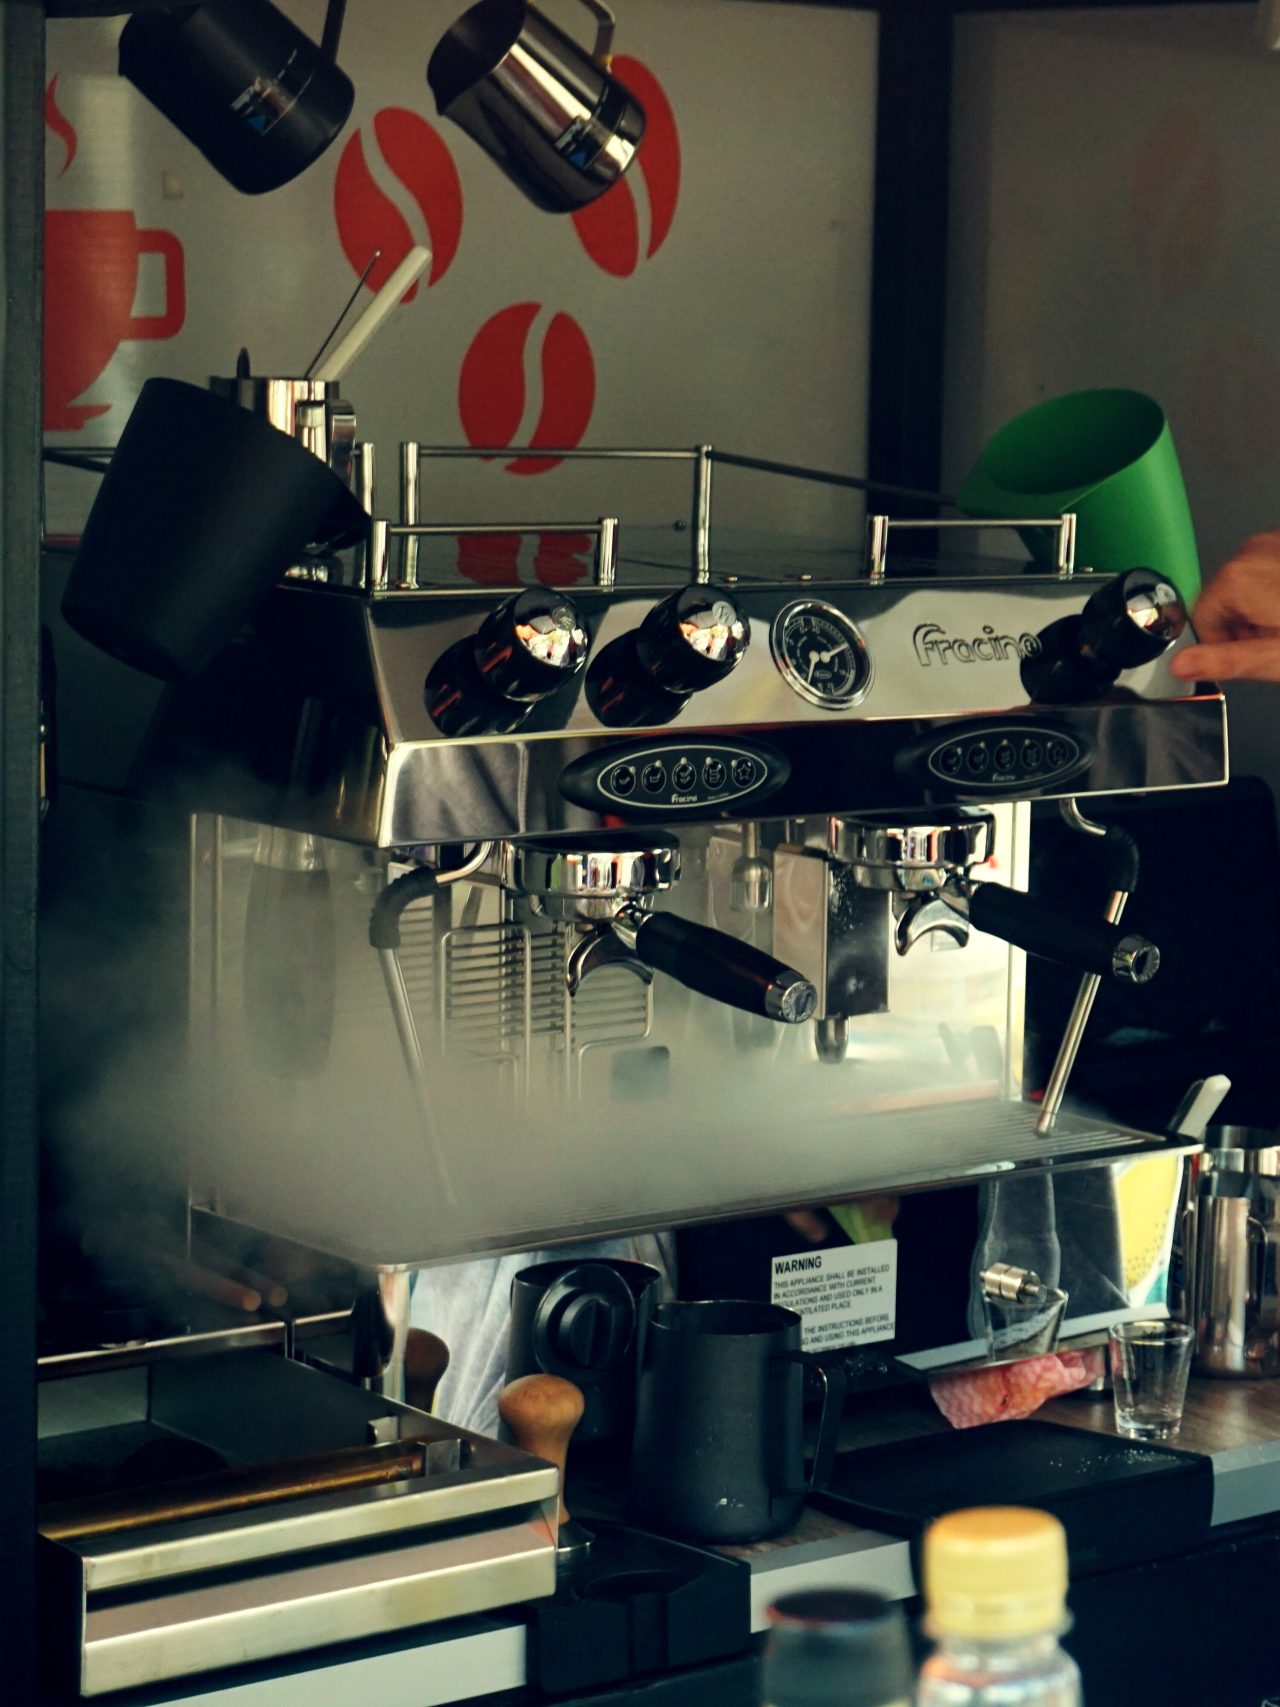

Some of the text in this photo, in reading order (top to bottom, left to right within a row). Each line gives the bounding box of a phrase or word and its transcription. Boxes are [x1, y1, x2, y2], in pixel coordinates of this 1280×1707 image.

[775, 1256, 822, 1275] WARNING
[774, 1264, 890, 1290] THIS APPLIANCE SHALL BE INSTALLED
[774, 1276, 876, 1299] IN ACCORDANCE WITH CURRENT
[780, 1296, 818, 1307] GULATIONS
[819, 1294, 832, 1302] AND
[834, 1290, 851, 1300] USED
[853, 1286, 869, 1297] ONLY
[870, 1286, 878, 1294] IN
[804, 1313, 889, 1335] THE INSTRUCTIONS BEFORE
[811, 1335, 825, 1344] AND
[825, 1332, 844, 1341] USING
[846, 1329, 860, 1338] THIS
